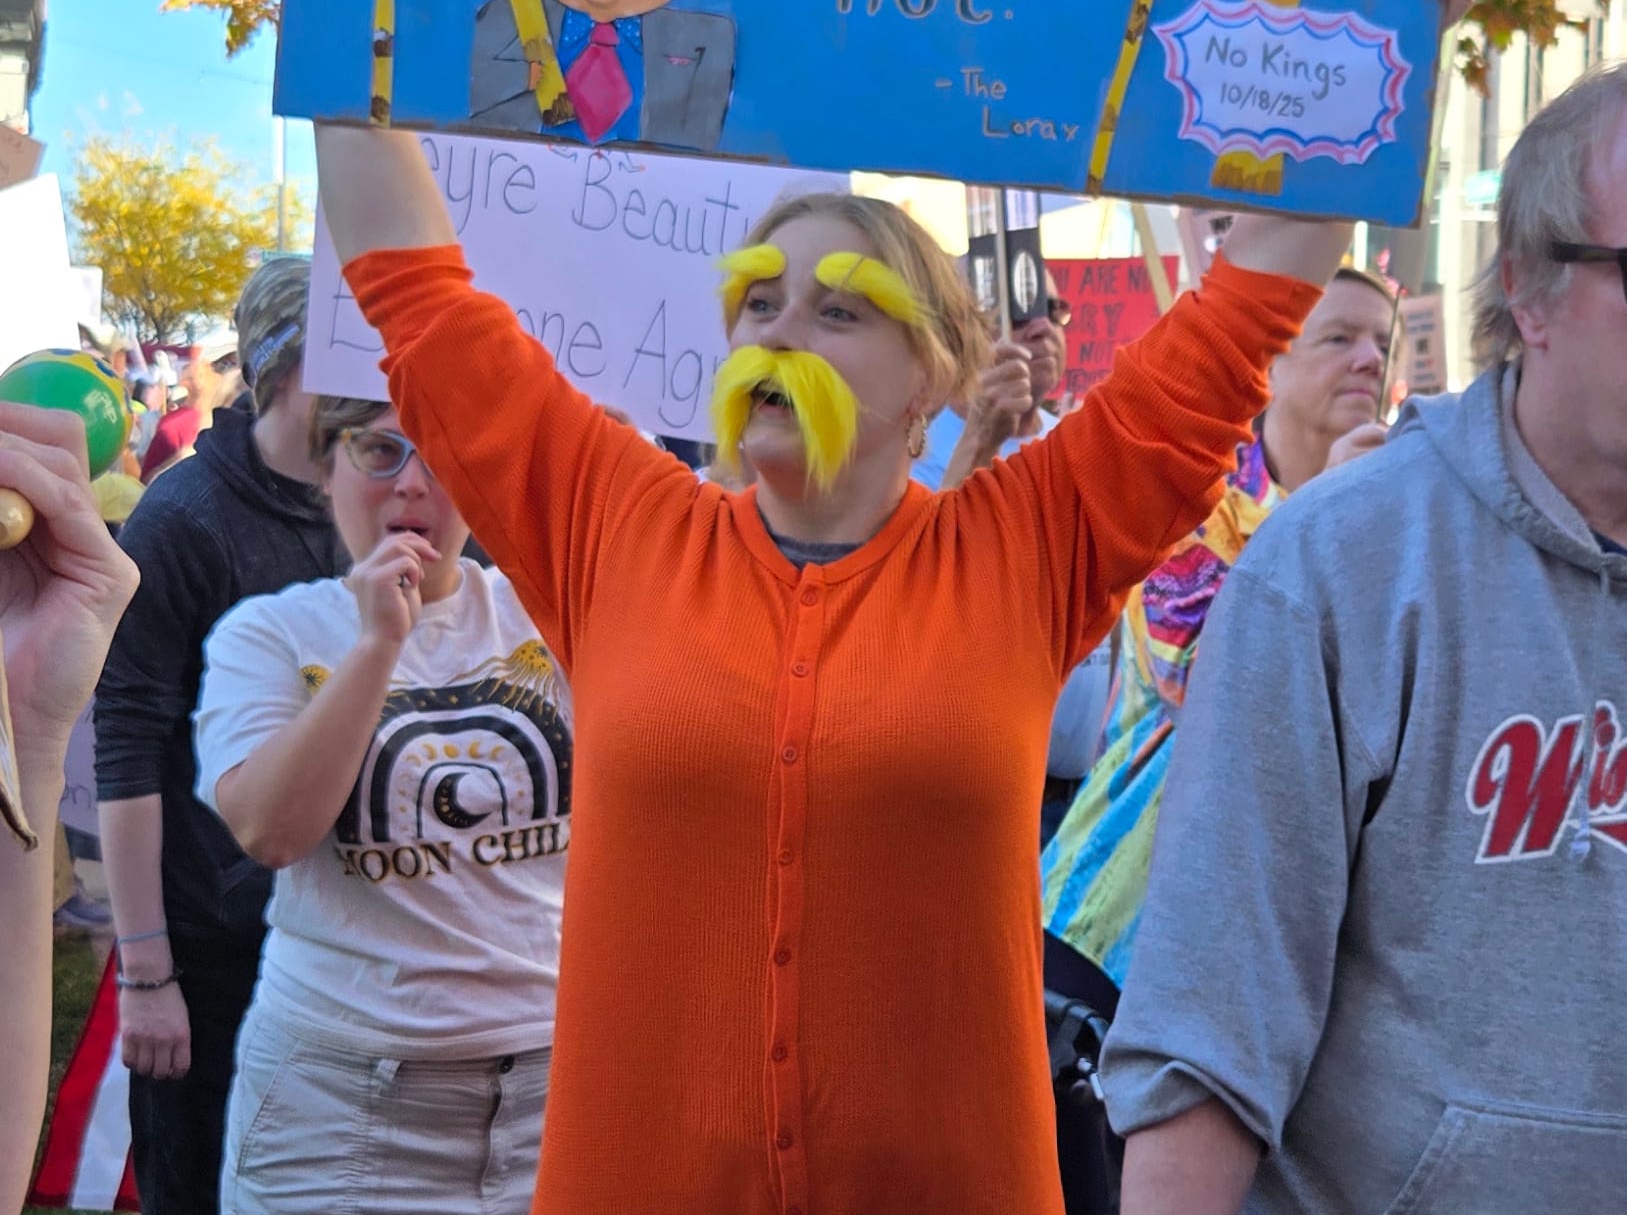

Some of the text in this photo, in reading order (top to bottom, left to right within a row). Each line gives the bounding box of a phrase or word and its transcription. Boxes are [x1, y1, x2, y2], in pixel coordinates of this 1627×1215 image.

[1205, 36, 1346, 101] No Kings
[1220, 82, 1305, 118] 10/18/25
[573, 151, 749, 257] Beaut
